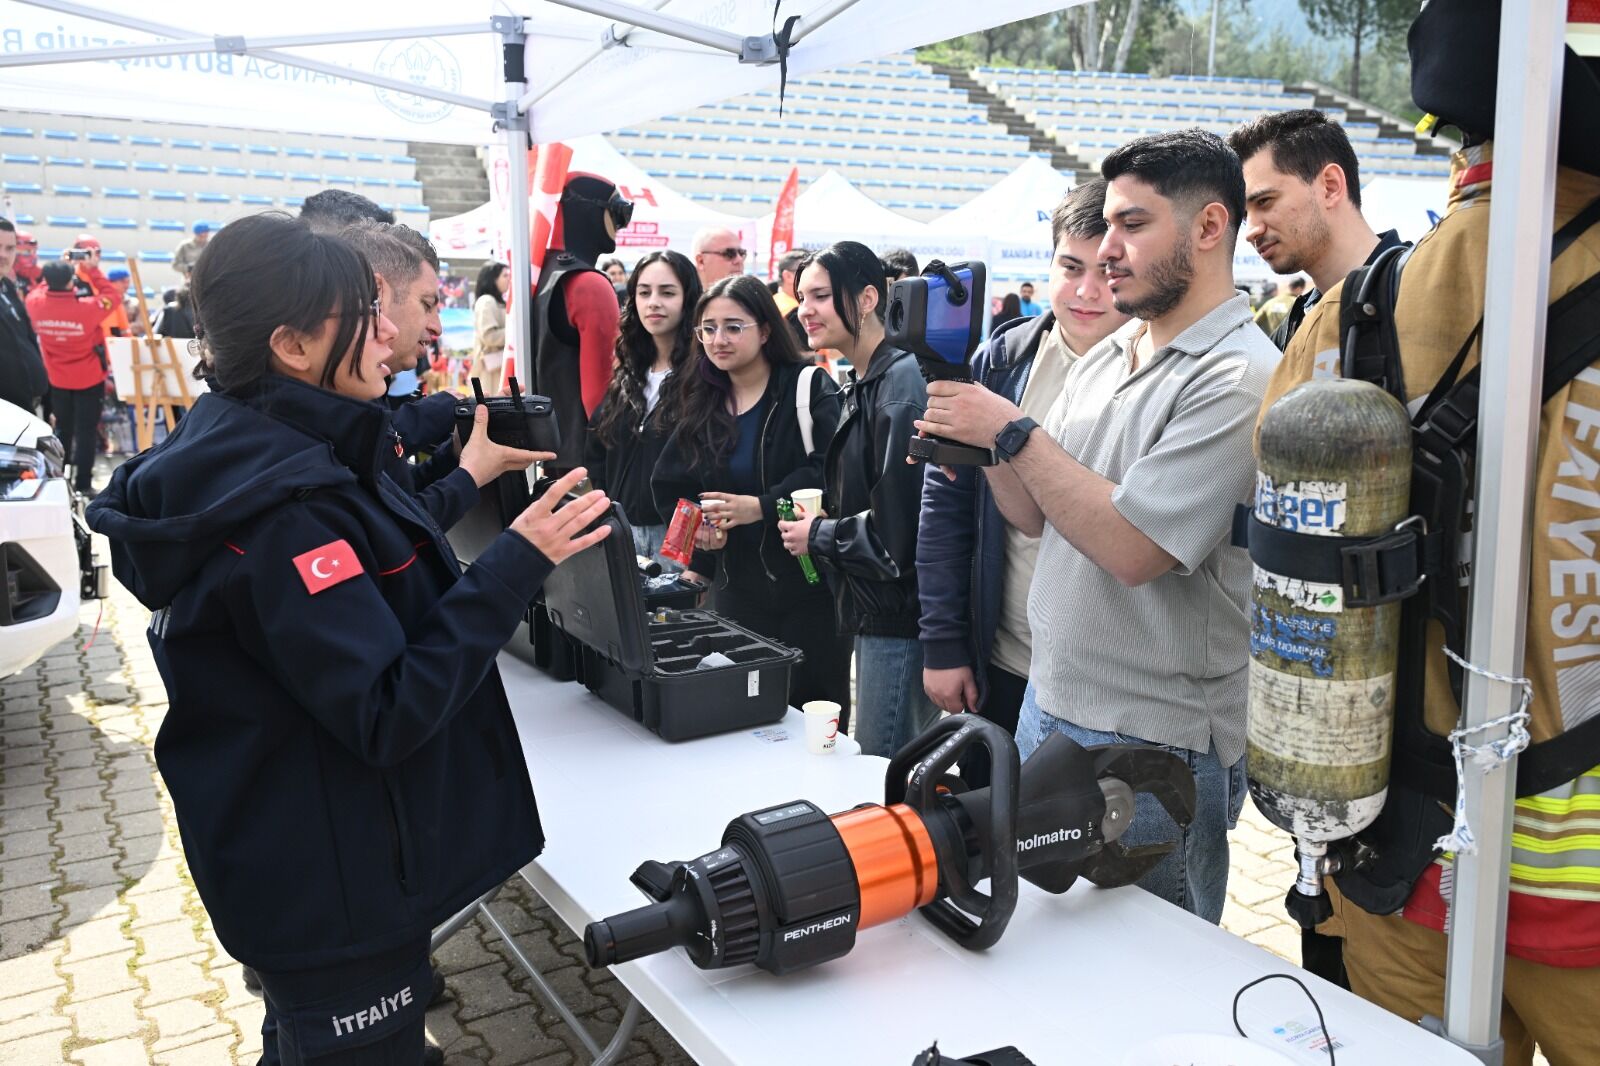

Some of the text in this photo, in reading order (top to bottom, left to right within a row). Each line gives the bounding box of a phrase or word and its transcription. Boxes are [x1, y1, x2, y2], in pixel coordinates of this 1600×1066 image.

[1016, 828, 1082, 853] holmatro
[784, 914, 851, 942] PENTHEON
[332, 986, 413, 1037] İTFAİYE
